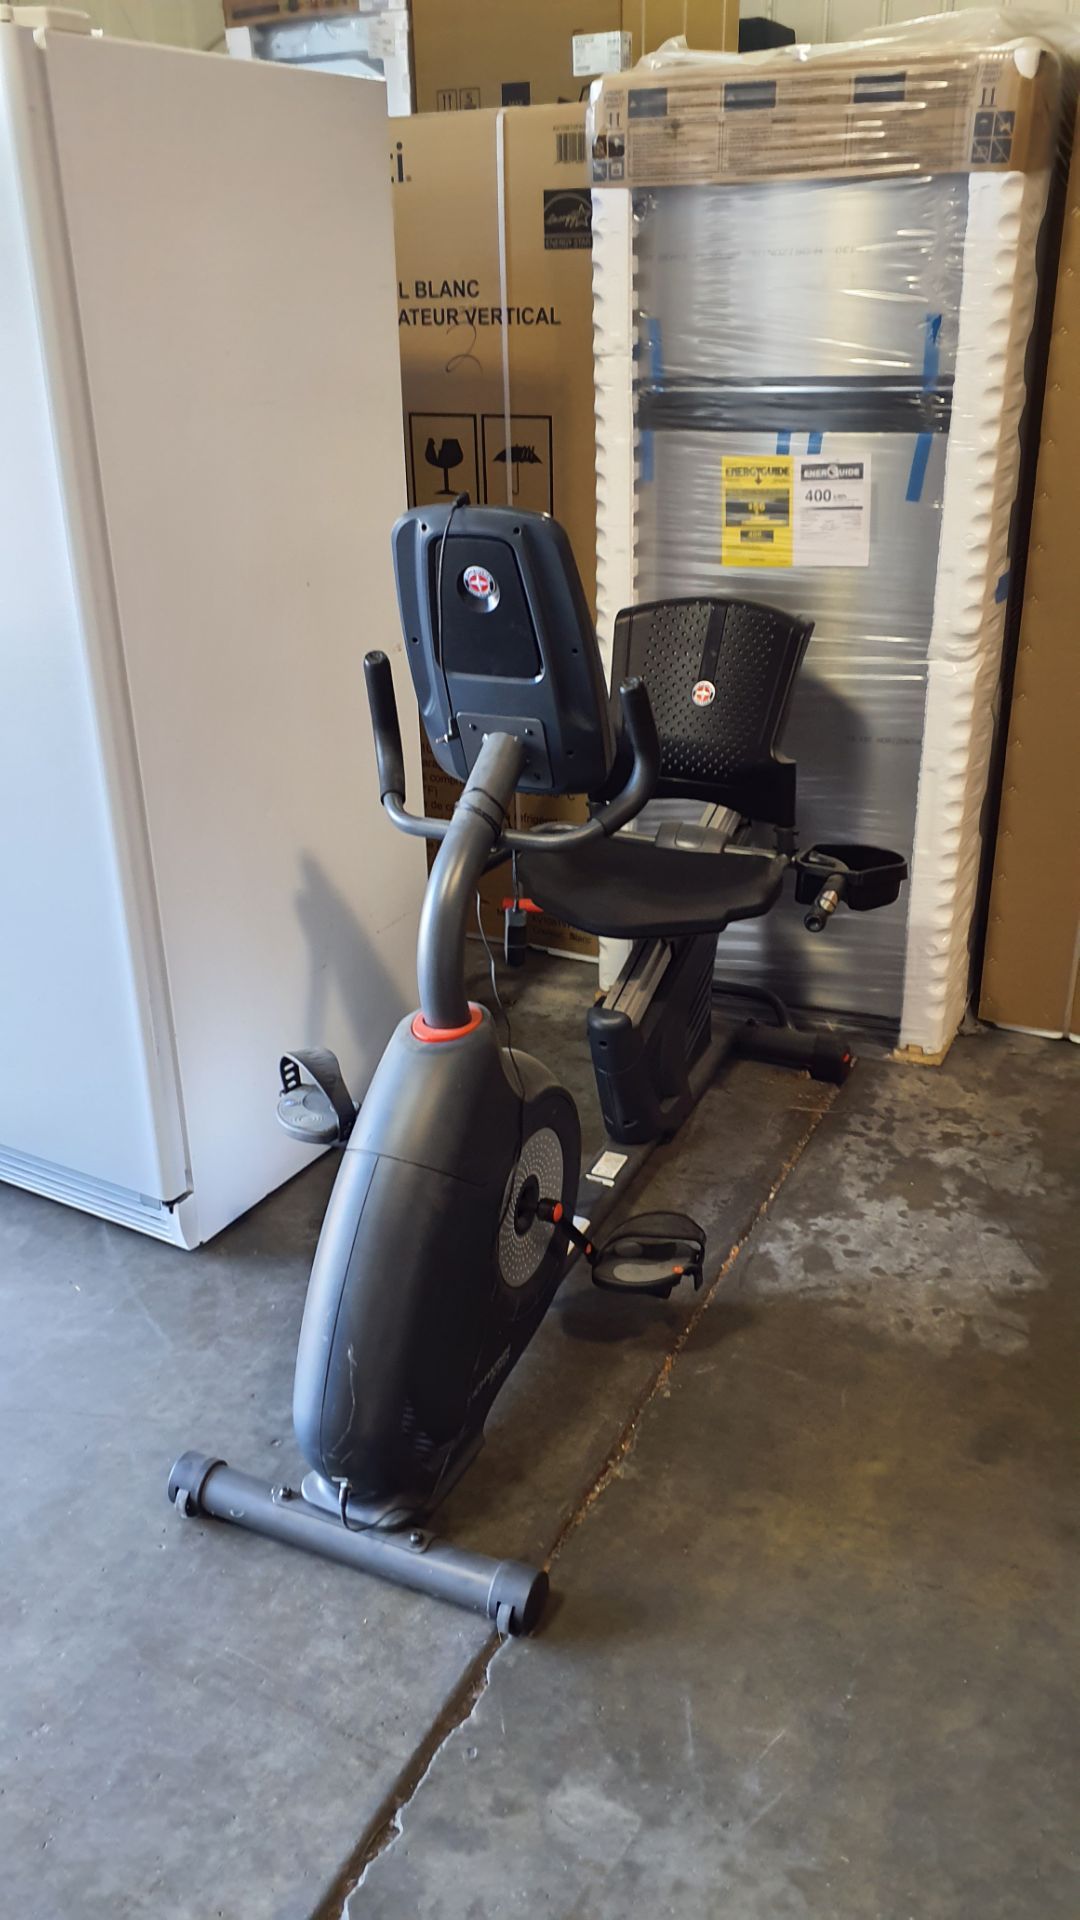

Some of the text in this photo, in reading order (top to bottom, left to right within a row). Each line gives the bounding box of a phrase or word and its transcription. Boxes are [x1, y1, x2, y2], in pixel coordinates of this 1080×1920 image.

[414, 280, 480, 299] BLANC
[398, 307, 561, 326] ATEUR VERTICAL
[805, 489, 832, 502] 400
